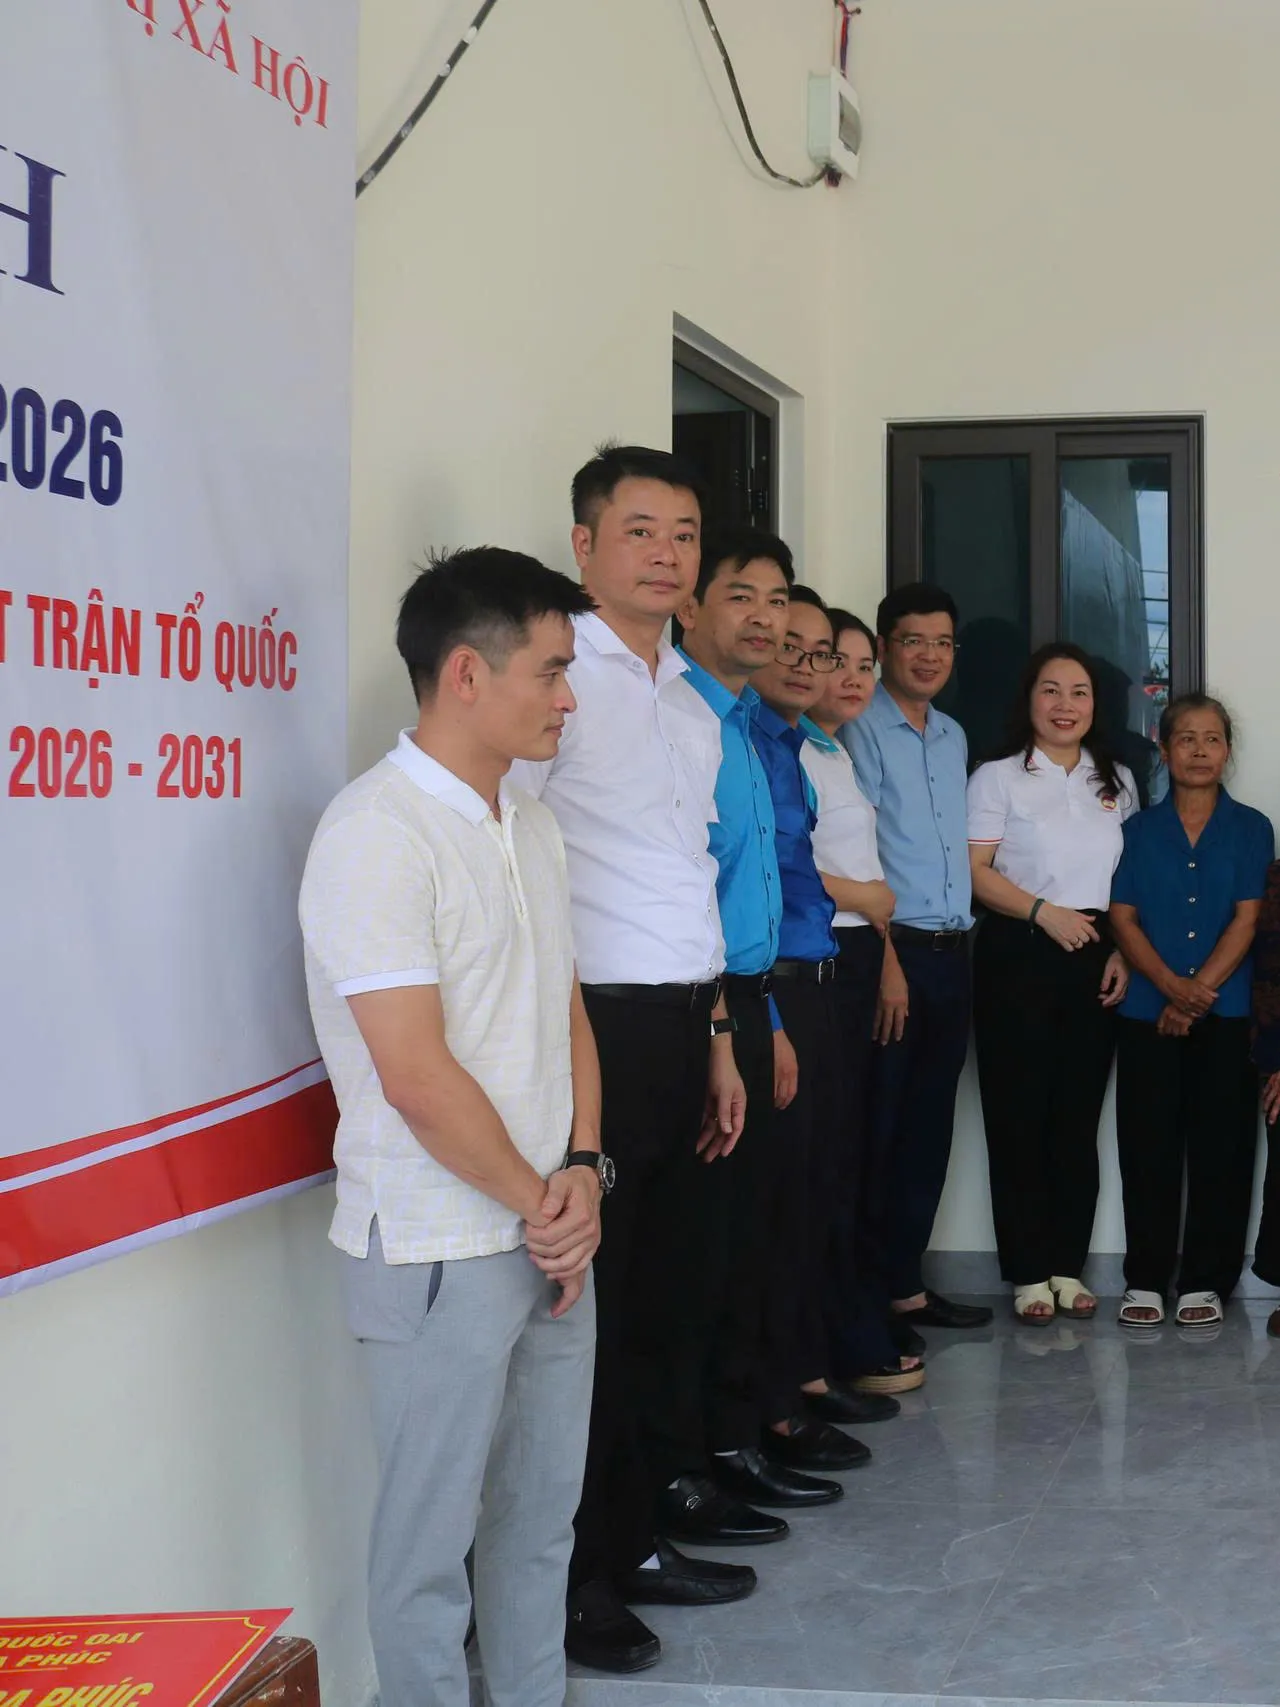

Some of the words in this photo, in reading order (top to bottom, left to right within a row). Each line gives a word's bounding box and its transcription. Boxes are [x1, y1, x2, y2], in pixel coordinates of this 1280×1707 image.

[250, 35, 331, 130] HỘI
[0, 384, 123, 507] 026
[27, 587, 142, 689] TRẬN
[155, 591, 206, 682] TỔ
[214, 608, 298, 693] QUỐC
[8, 725, 113, 799] 2026
[156, 733, 242, 799] 2031
[15, 1650, 112, 1668] PHÚC
[84, 1631, 144, 1646] OAI
